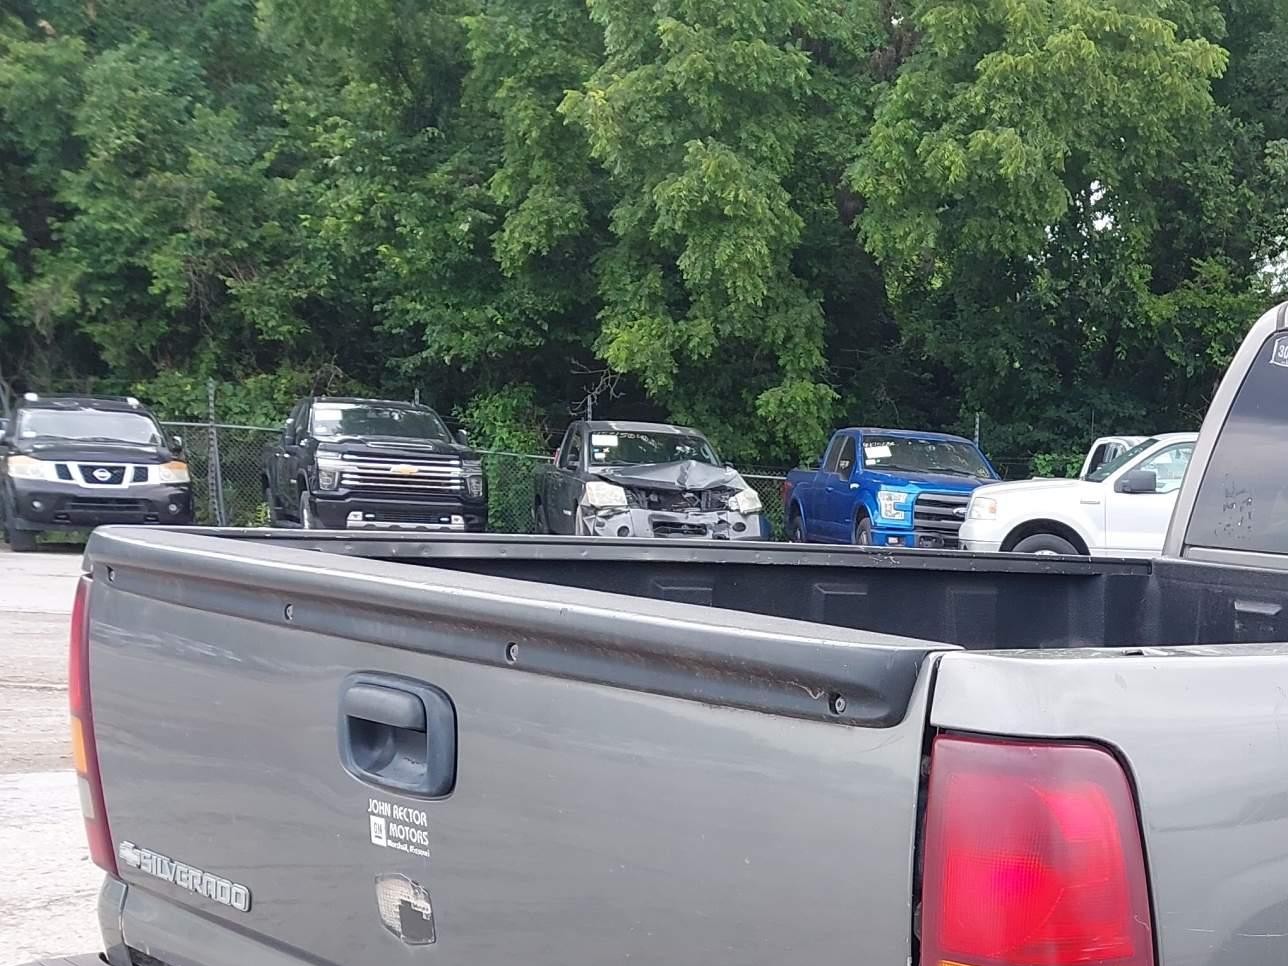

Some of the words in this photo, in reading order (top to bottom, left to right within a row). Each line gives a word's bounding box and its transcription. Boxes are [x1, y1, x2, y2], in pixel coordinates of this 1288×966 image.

[368, 798, 391, 817] JOHN
[393, 804, 427, 827] RECTOR
[389, 822, 429, 846] MOTORS
[140, 848, 251, 912] SILVERADO
